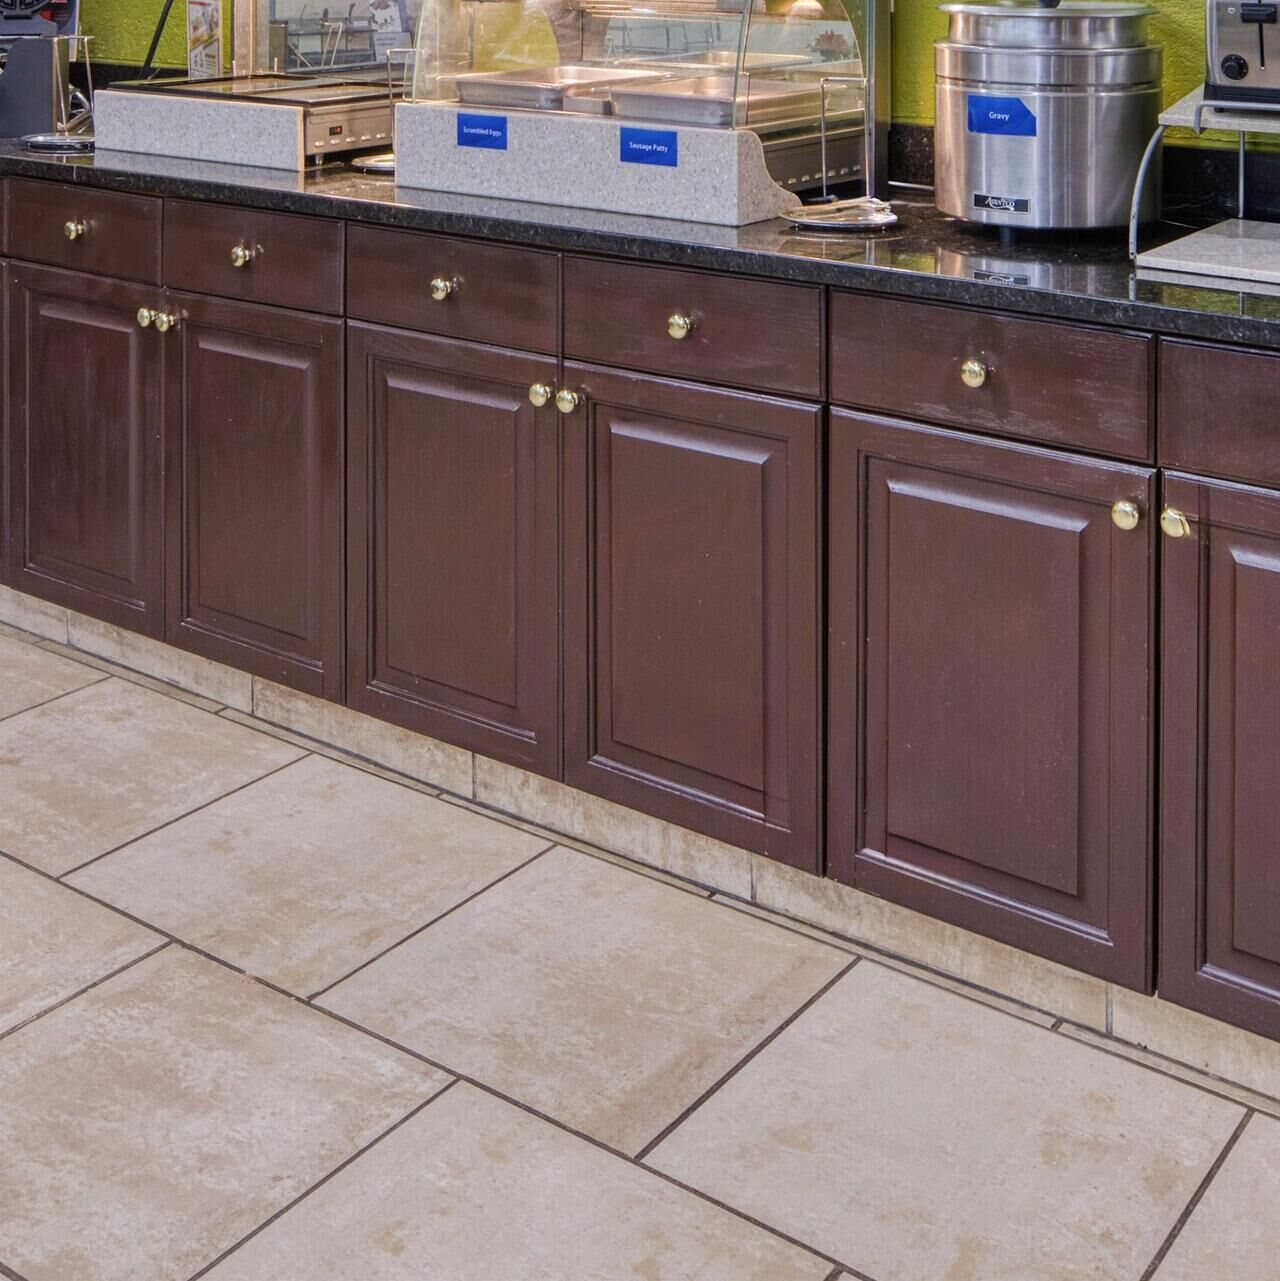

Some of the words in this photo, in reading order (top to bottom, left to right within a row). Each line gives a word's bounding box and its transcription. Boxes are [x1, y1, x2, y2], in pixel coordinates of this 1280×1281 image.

[988, 111, 1010, 121] Gravy
[463, 126, 488, 135] Scrambled
[489, 129, 502, 137] Eggs
[629, 141, 652, 151] Sausage
[652, 144, 669, 153] Patty
